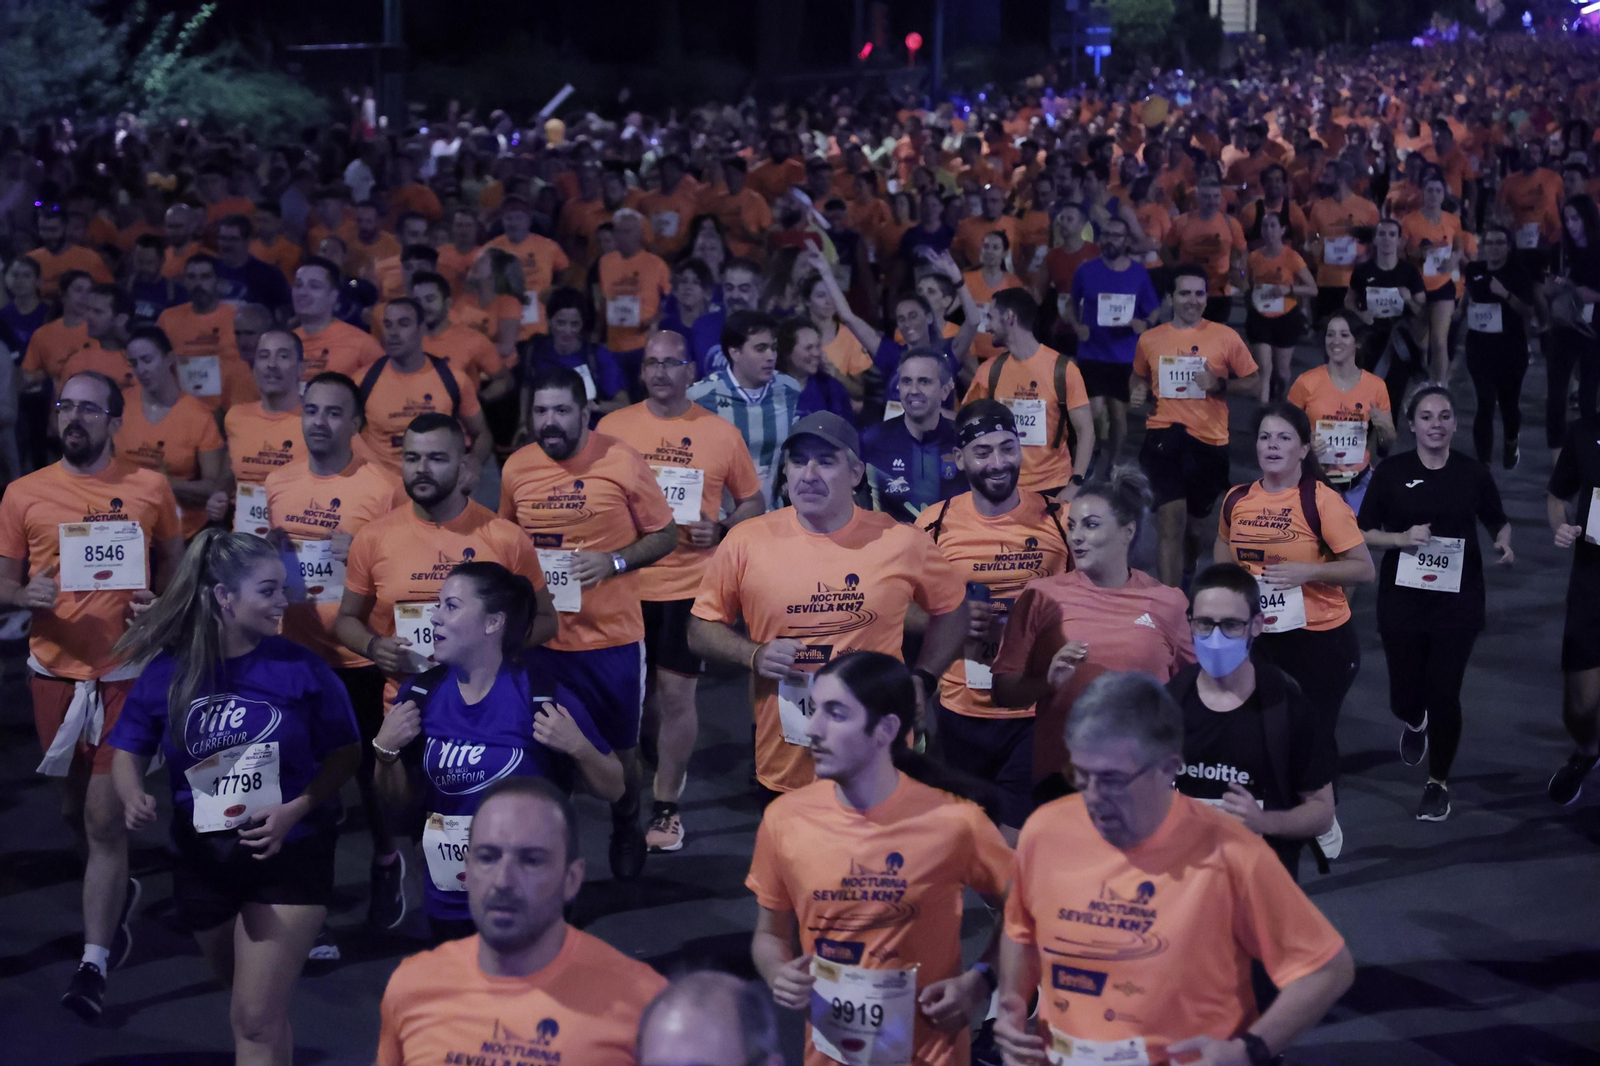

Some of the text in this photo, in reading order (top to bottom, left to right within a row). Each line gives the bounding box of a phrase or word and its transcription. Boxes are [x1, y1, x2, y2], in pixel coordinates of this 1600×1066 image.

[1169, 370, 1196, 382] 11115
[1014, 416, 1036, 426] 7822
[1328, 436, 1358, 446] 11116
[643, 454, 671, 462] EVILLA
[656, 448, 694, 458] NOCTURNA
[664, 486, 686, 500] 178
[82, 514, 128, 522] NOCTURNA
[285, 514, 318, 526] SEVILLA
[303, 510, 341, 521] NOCTURNA
[1256, 515, 1292, 523] NOCTURNA
[1238, 519, 1270, 528] SEVILLA
[84, 545, 124, 562] 8546
[994, 552, 1044, 562] NOCTURNA
[1418, 552, 1448, 568] 9349
[300, 561, 333, 578] 8944
[973, 562, 1016, 572] SEVILLA
[810, 592, 865, 602] NOCTURNA
[1260, 592, 1286, 609] 944
[786, 602, 834, 614] SEVILLA
[414, 628, 435, 644] 18
[192, 731, 248, 755] CARREFOUR
[213, 772, 262, 796] 17798
[436, 770, 486, 786] CARREFOUR
[841, 877, 908, 888] NOCTURNA
[813, 890, 868, 901] SEVILLA
[1088, 900, 1156, 918] NOCTURNA
[1058, 908, 1115, 928] SEVILLA
[832, 997, 884, 1027] 9919
[480, 1042, 560, 1062] NOCTURNA
